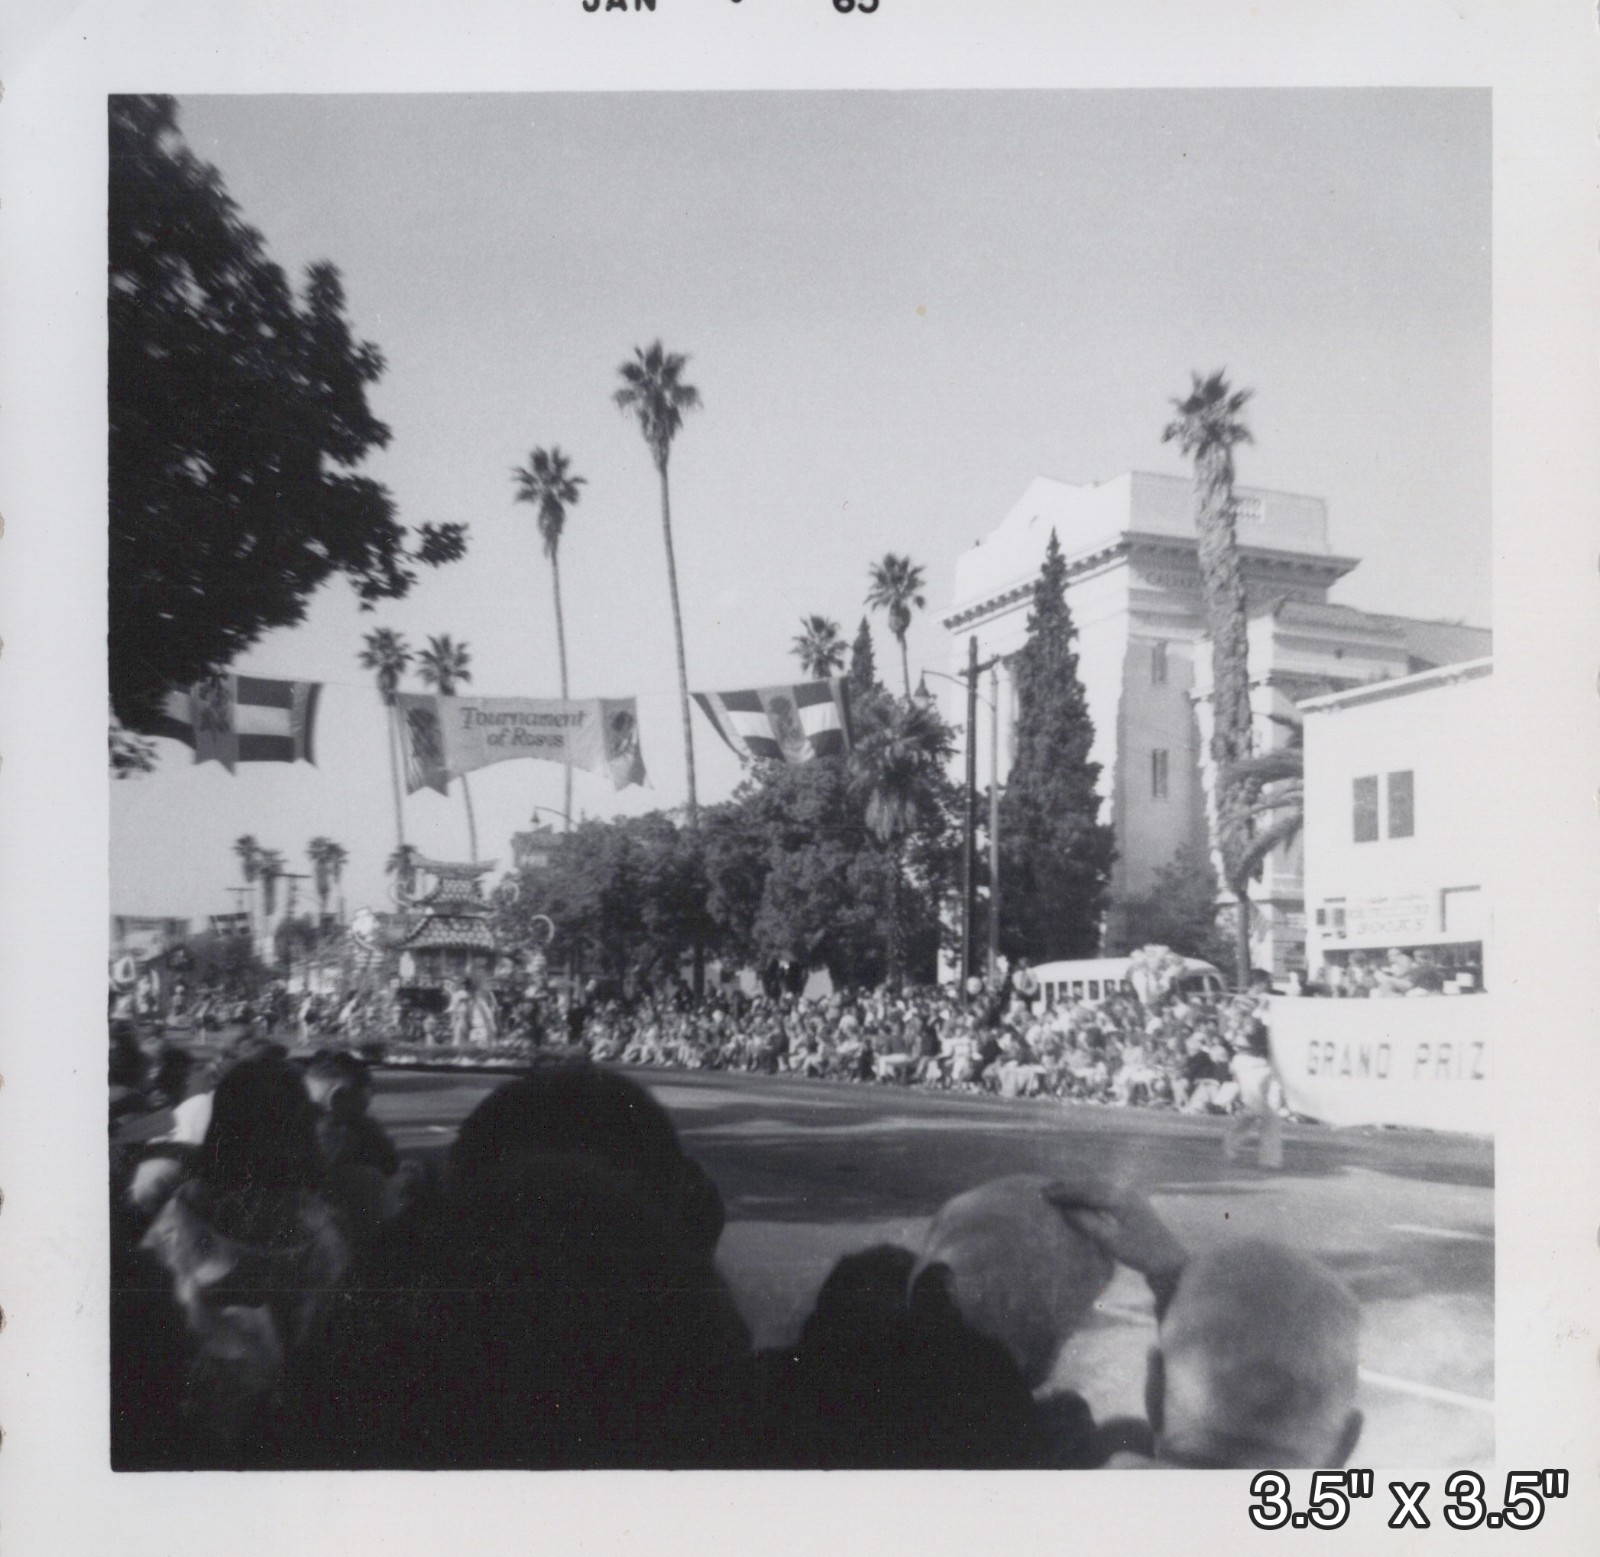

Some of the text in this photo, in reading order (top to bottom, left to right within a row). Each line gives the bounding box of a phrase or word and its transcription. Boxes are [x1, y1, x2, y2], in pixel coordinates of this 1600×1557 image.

[460, 706, 585, 729] Tournament
[487, 728, 564, 747] of Roses
[1307, 1039, 1391, 1080] GRAND
